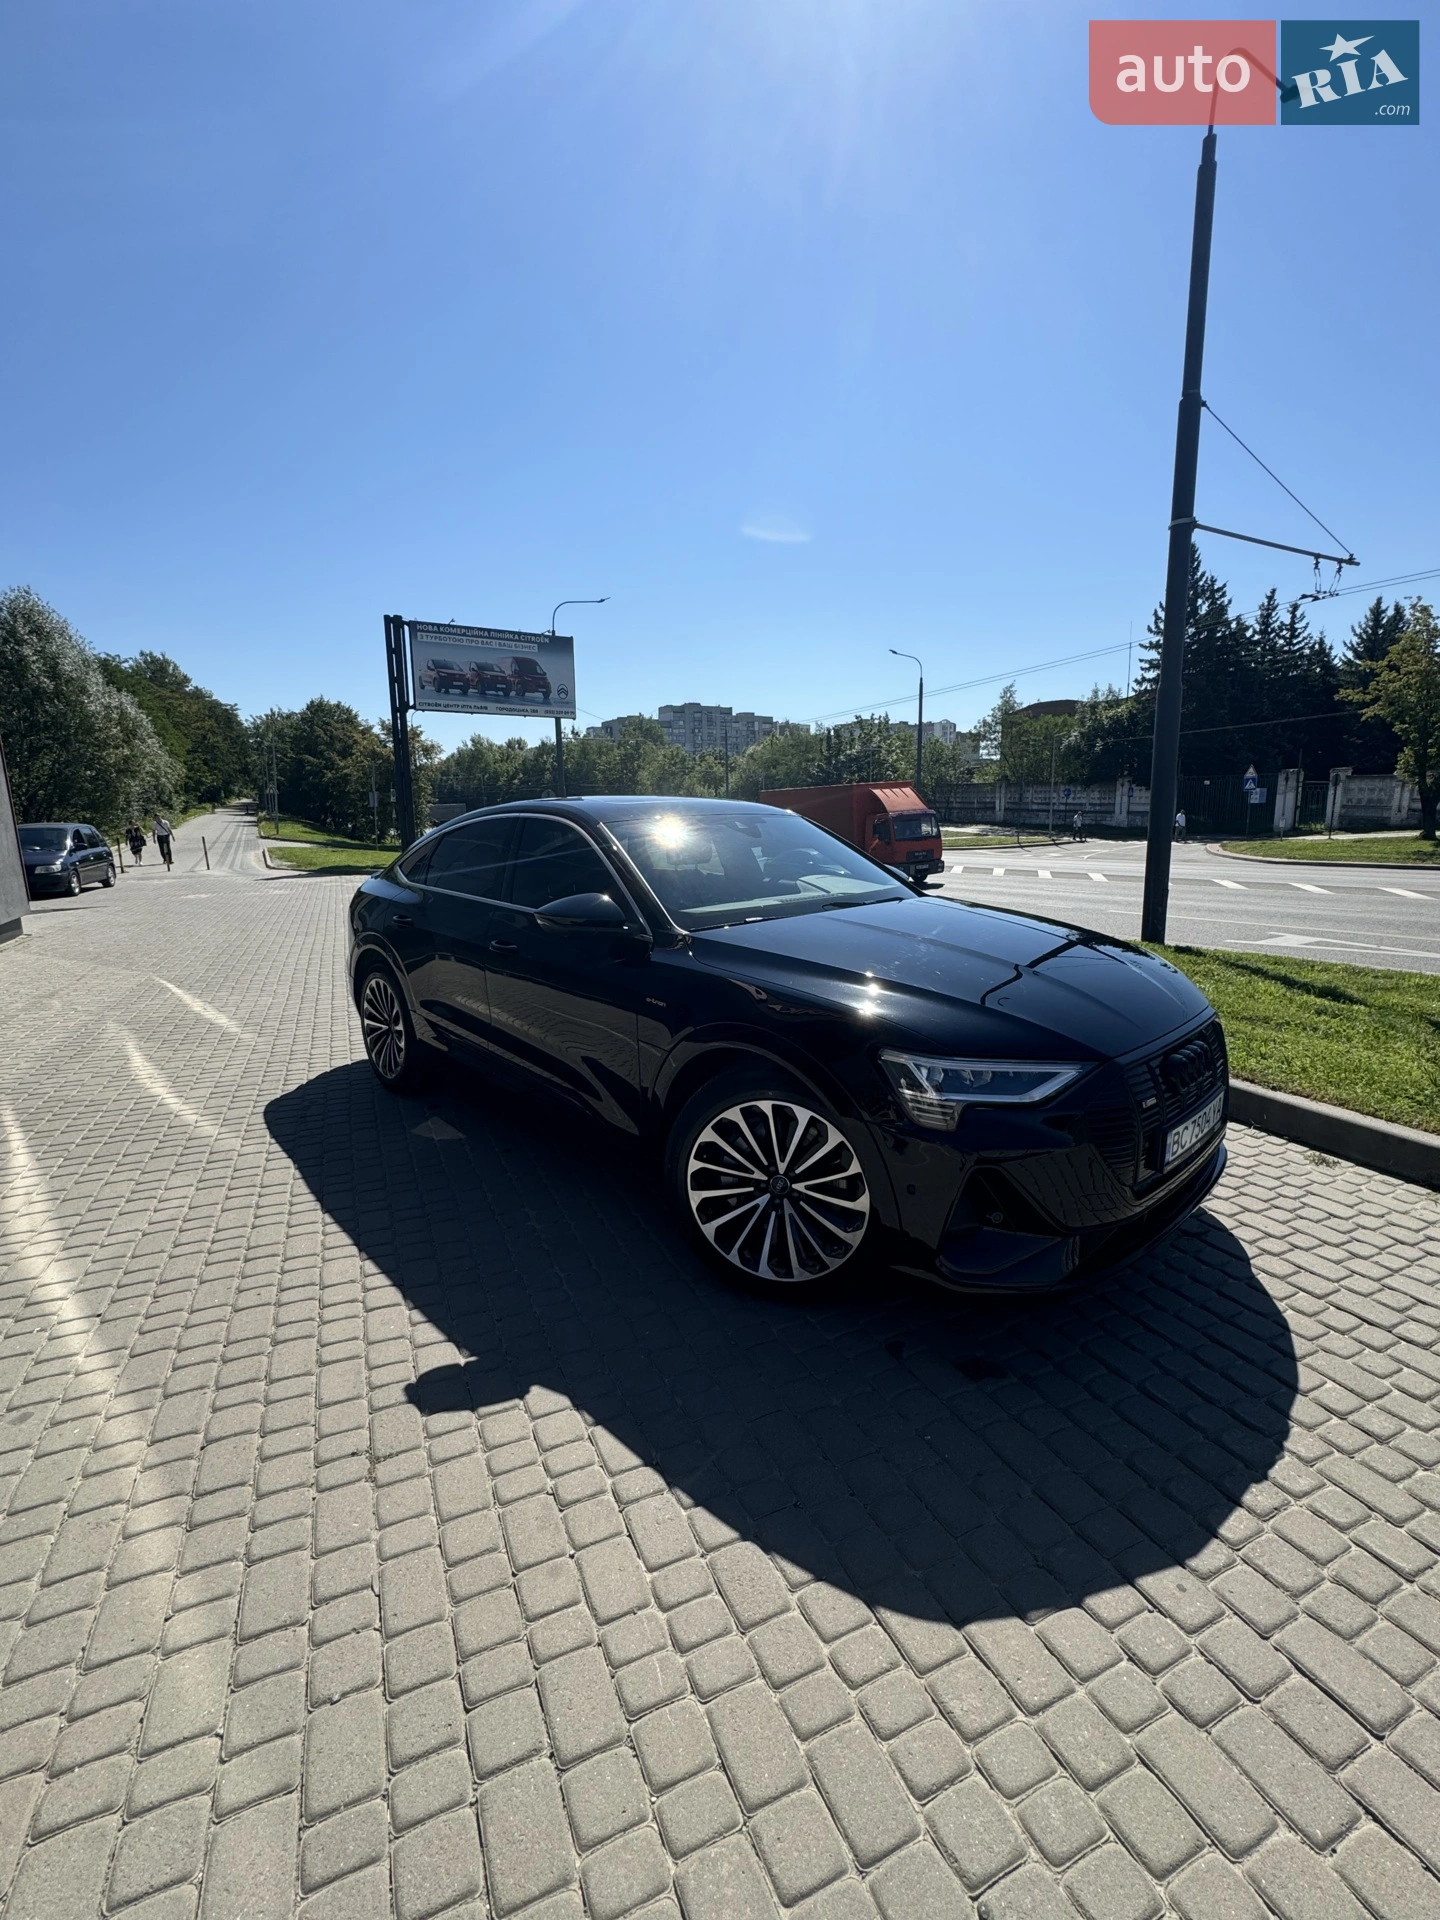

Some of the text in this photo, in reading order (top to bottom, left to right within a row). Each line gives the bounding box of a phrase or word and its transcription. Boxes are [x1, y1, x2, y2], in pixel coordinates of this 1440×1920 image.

[416, 624, 438, 632] НОВА
[439, 626, 489, 637] КОМЕРЦІЙНА
[490, 631, 519, 641] ЛІНІЙКА
[425, 634, 464, 643] ТУРБОТОЮ
[514, 643, 536, 651] БІЗНЕС
[1171, 1126, 1189, 1156] BC
[1189, 1107, 1212, 1145] 7504
